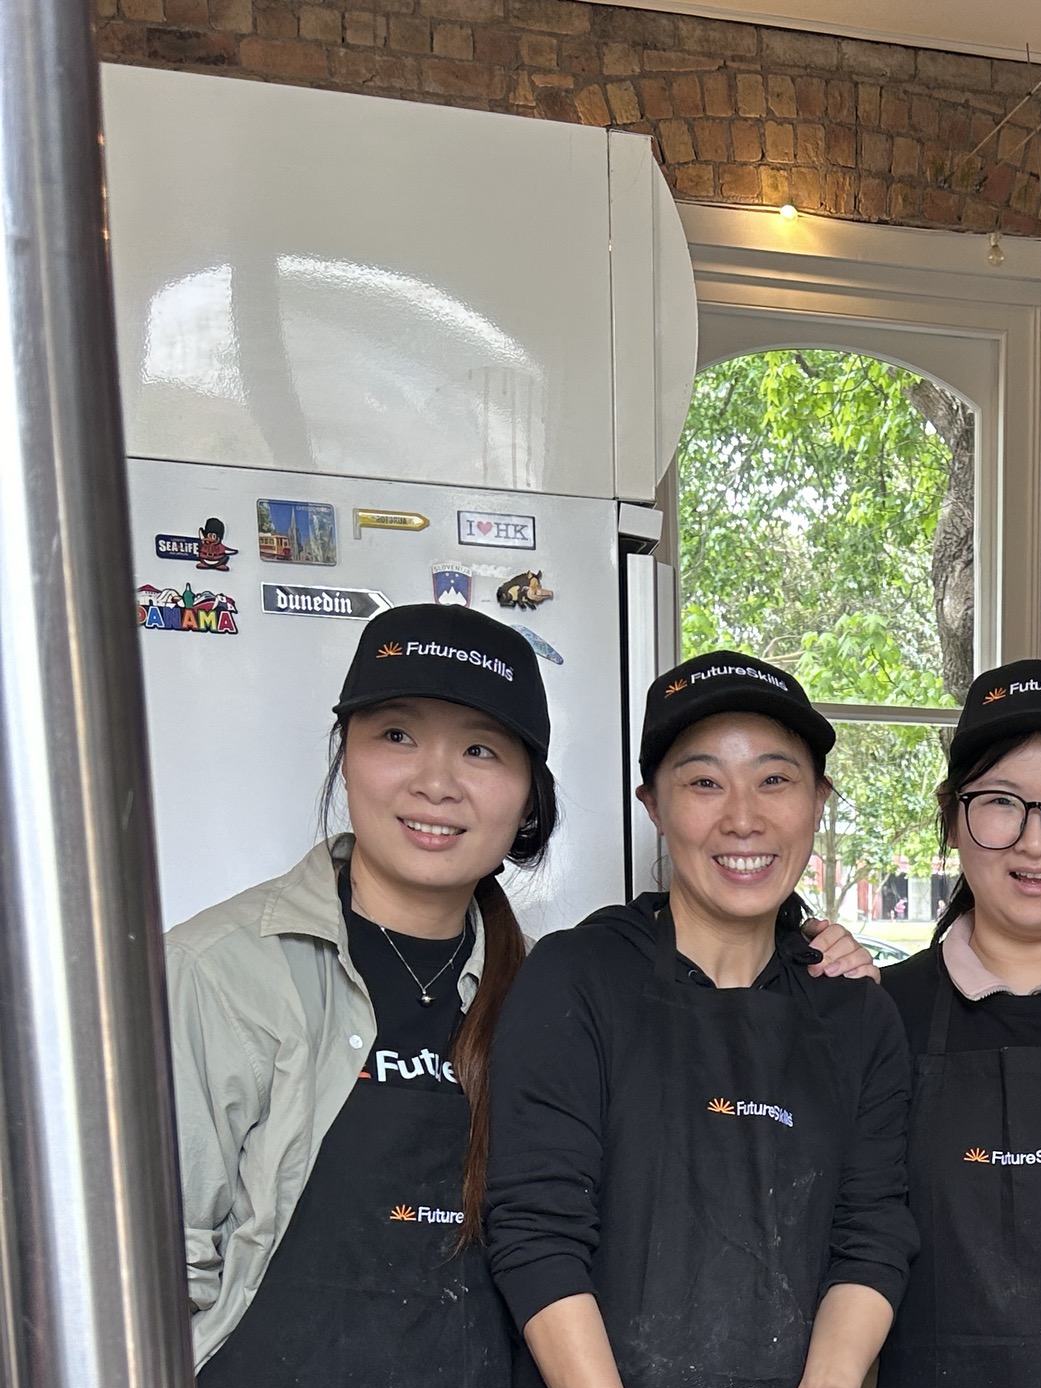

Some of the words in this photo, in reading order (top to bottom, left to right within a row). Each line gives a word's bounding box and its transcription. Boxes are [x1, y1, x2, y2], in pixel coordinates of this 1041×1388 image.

[466, 519, 476, 537] I
[494, 521, 529, 541] HK
[158, 539, 179, 553] SEA
[432, 563, 471, 576] SLOVENIJA
[405, 641, 514, 682] FutureSkills
[690, 665, 788, 692] FutureSkills
